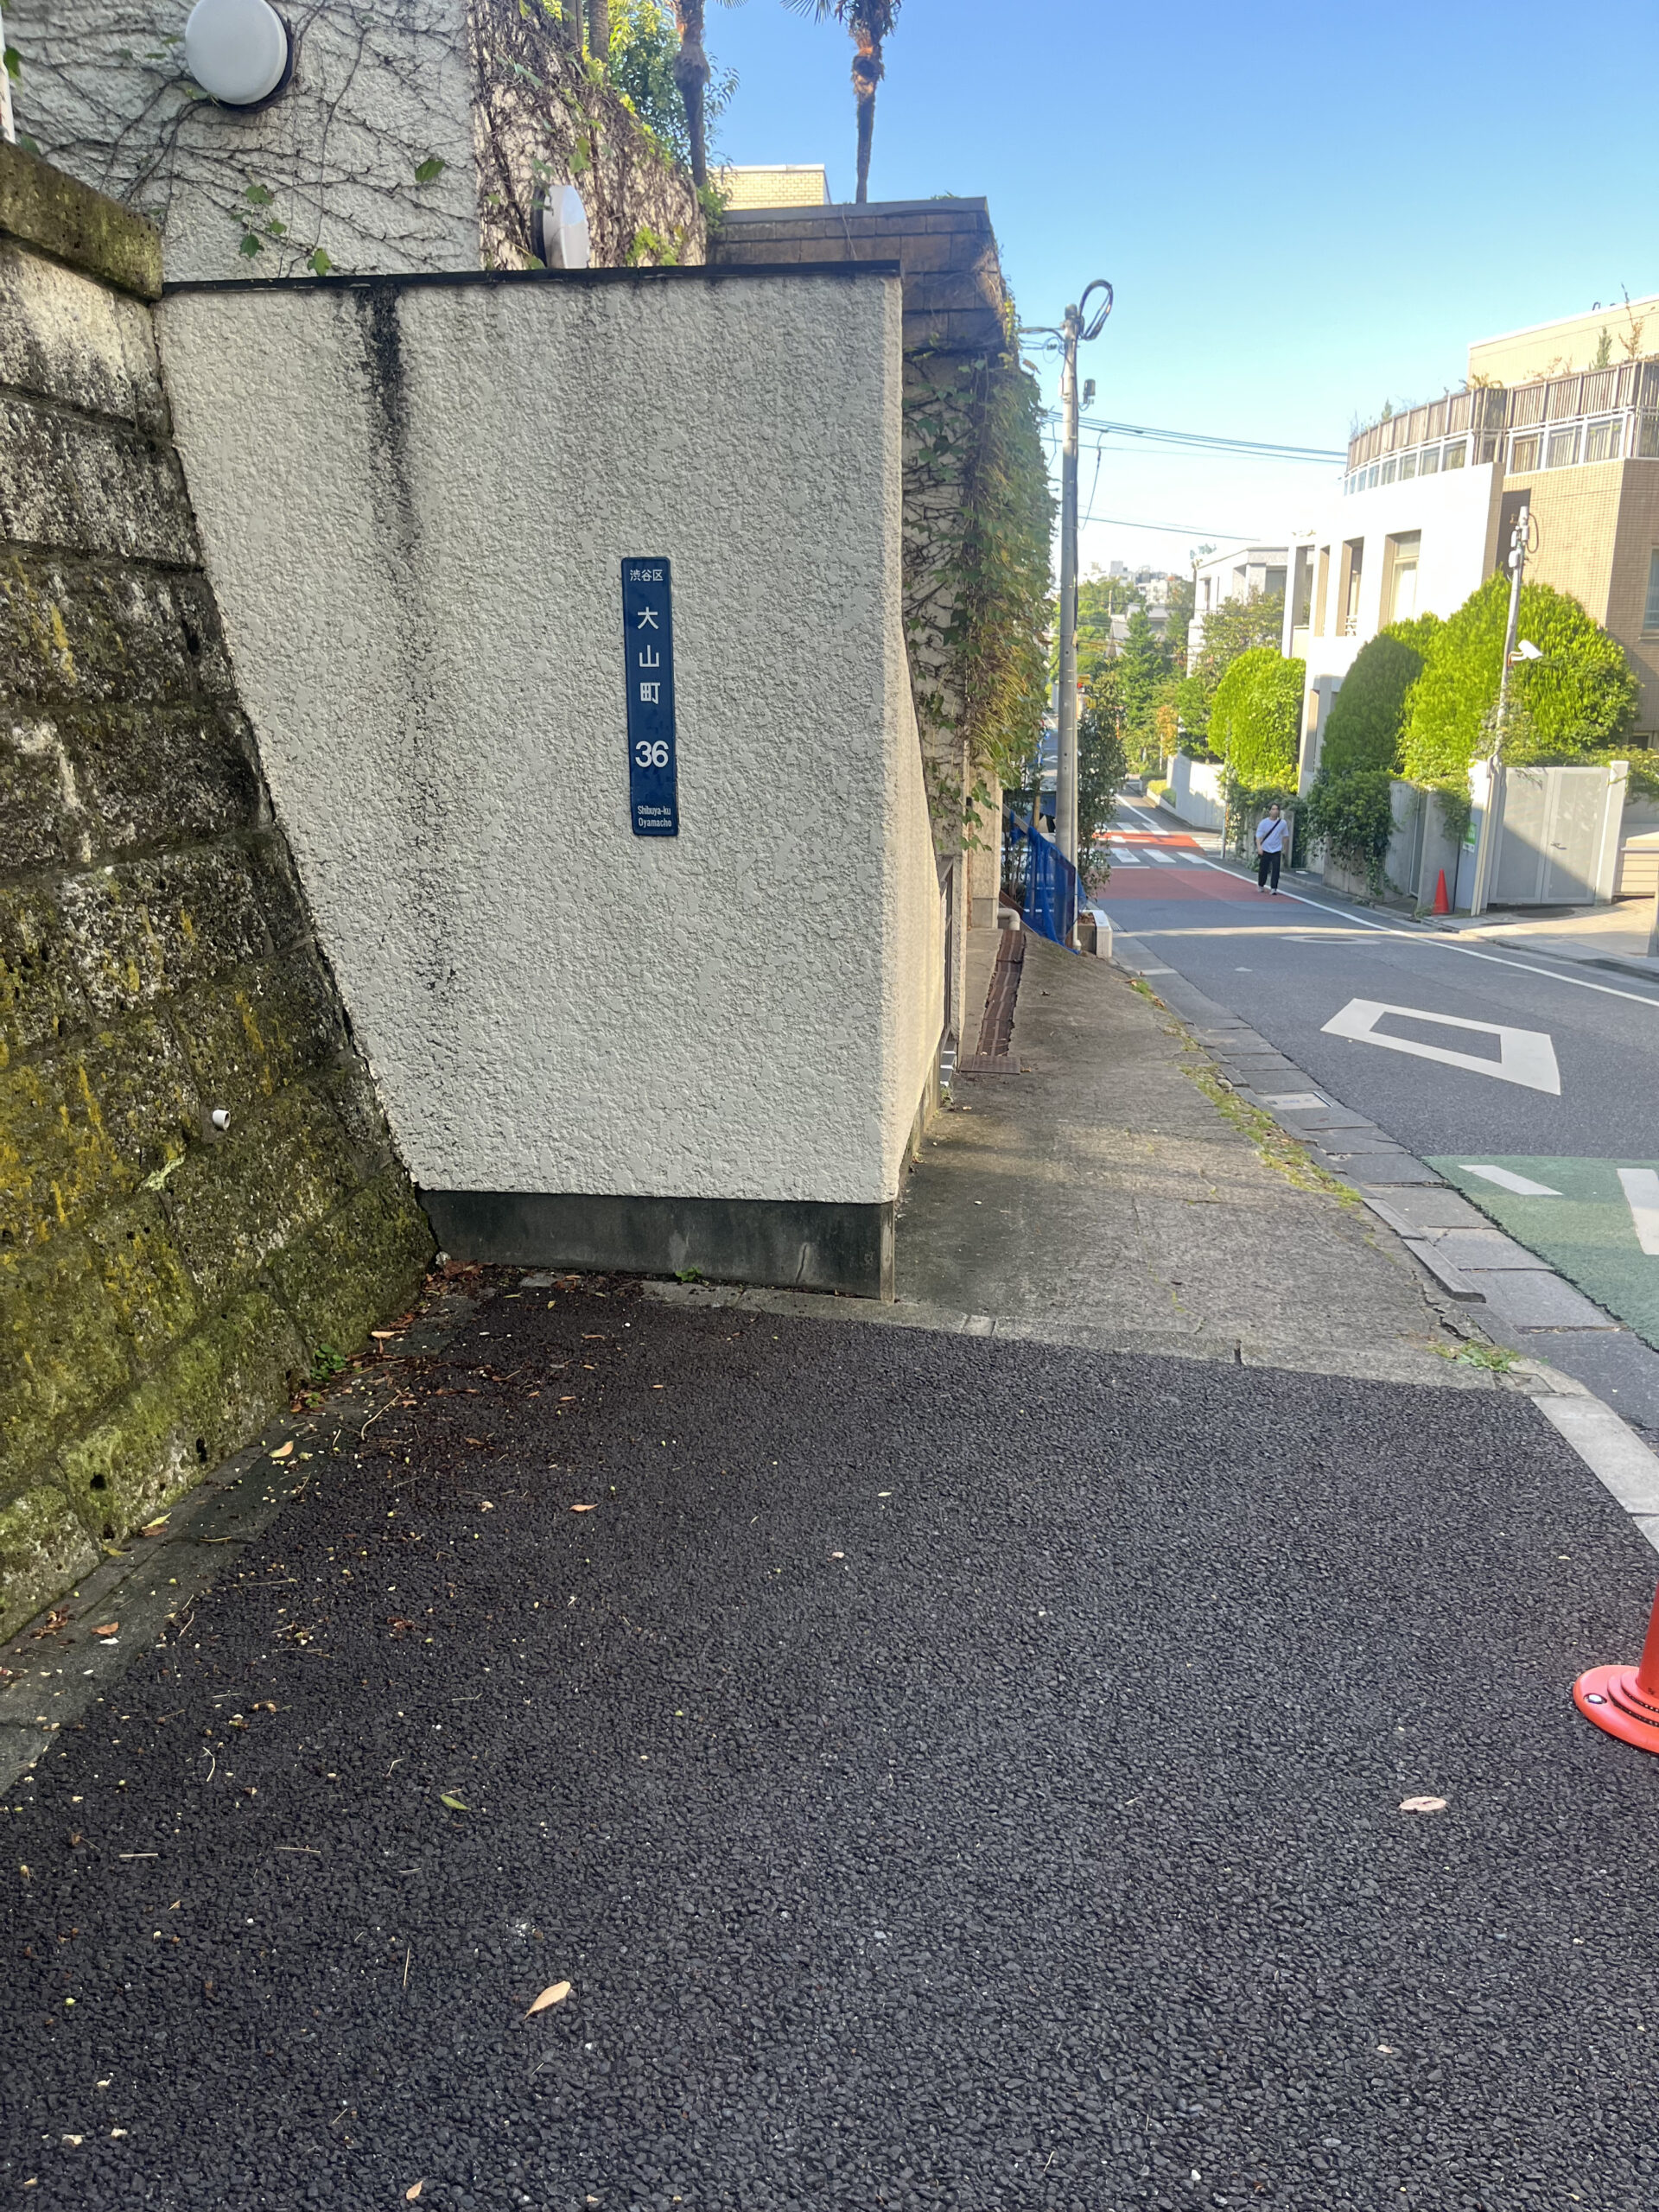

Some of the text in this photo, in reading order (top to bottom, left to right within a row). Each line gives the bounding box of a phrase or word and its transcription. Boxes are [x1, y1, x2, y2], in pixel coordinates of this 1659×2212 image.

[630, 569, 664, 582] 渋谷区
[637, 606, 661, 704] 大山町
[635, 740, 669, 767] 36
[637, 805, 671, 817] Shibuya-ku
[638, 817, 672, 829] Oyamacho
